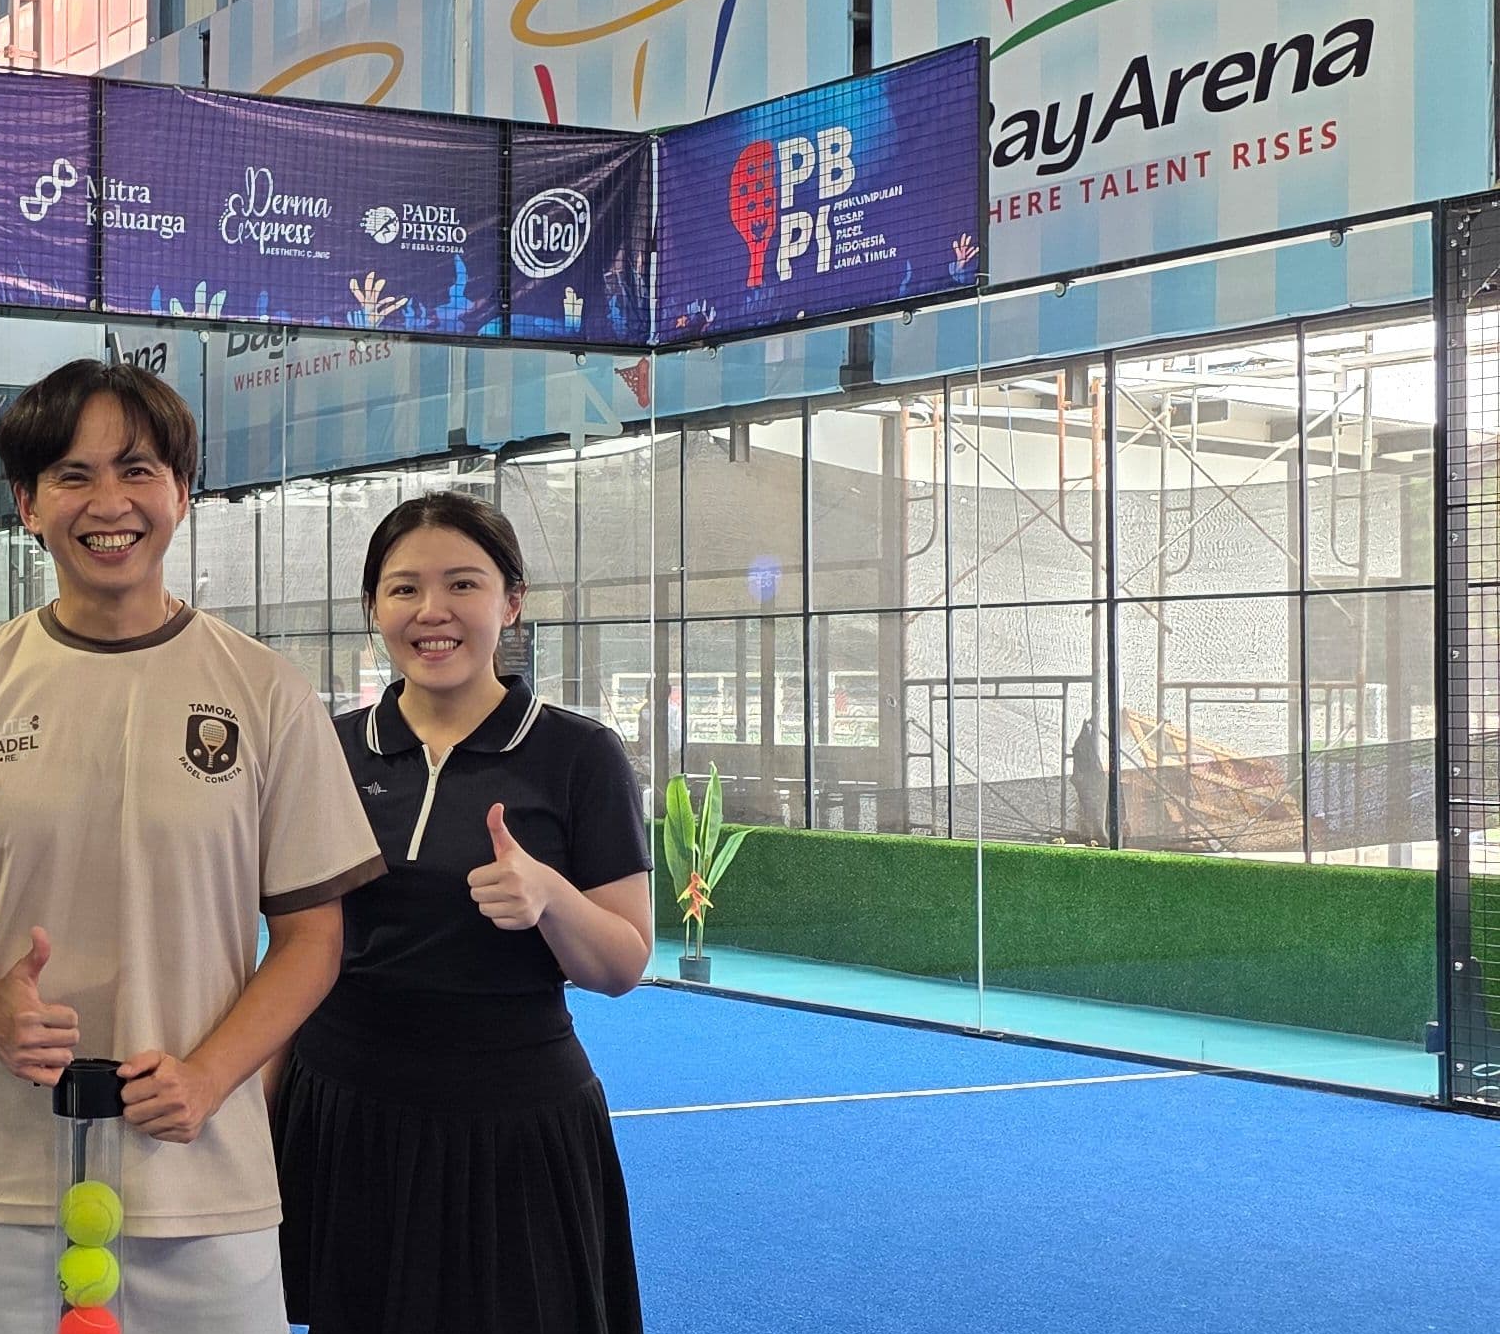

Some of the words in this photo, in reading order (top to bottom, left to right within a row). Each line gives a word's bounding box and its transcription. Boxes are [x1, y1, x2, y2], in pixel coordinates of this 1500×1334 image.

[989, 18, 1374, 175] ayArena
[778, 126, 855, 209] PB
[989, 186, 1062, 224] HERE
[1080, 150, 1212, 203] TALENT
[1232, 120, 1339, 169] RISES
[85, 175, 151, 204] Mitra
[242, 167, 333, 218] Derma
[222, 194, 315, 255] Express
[401, 222, 467, 243] PHYSIO
[402, 204, 460, 225] PADEL
[529, 214, 574, 253] Cleo
[777, 205, 832, 282] PI
[834, 254, 862, 270] JAWA
[865, 247, 897, 263] TIMUR
[835, 234, 885, 255] INDONESIA
[234, 367, 281, 392] WHERE
[286, 352, 342, 380] TALENT
[349, 341, 391, 367] RISES
[188, 703, 238, 722] TAMORA
[179, 756, 201, 779] PADEL
[204, 766, 242, 784] CONECTA
